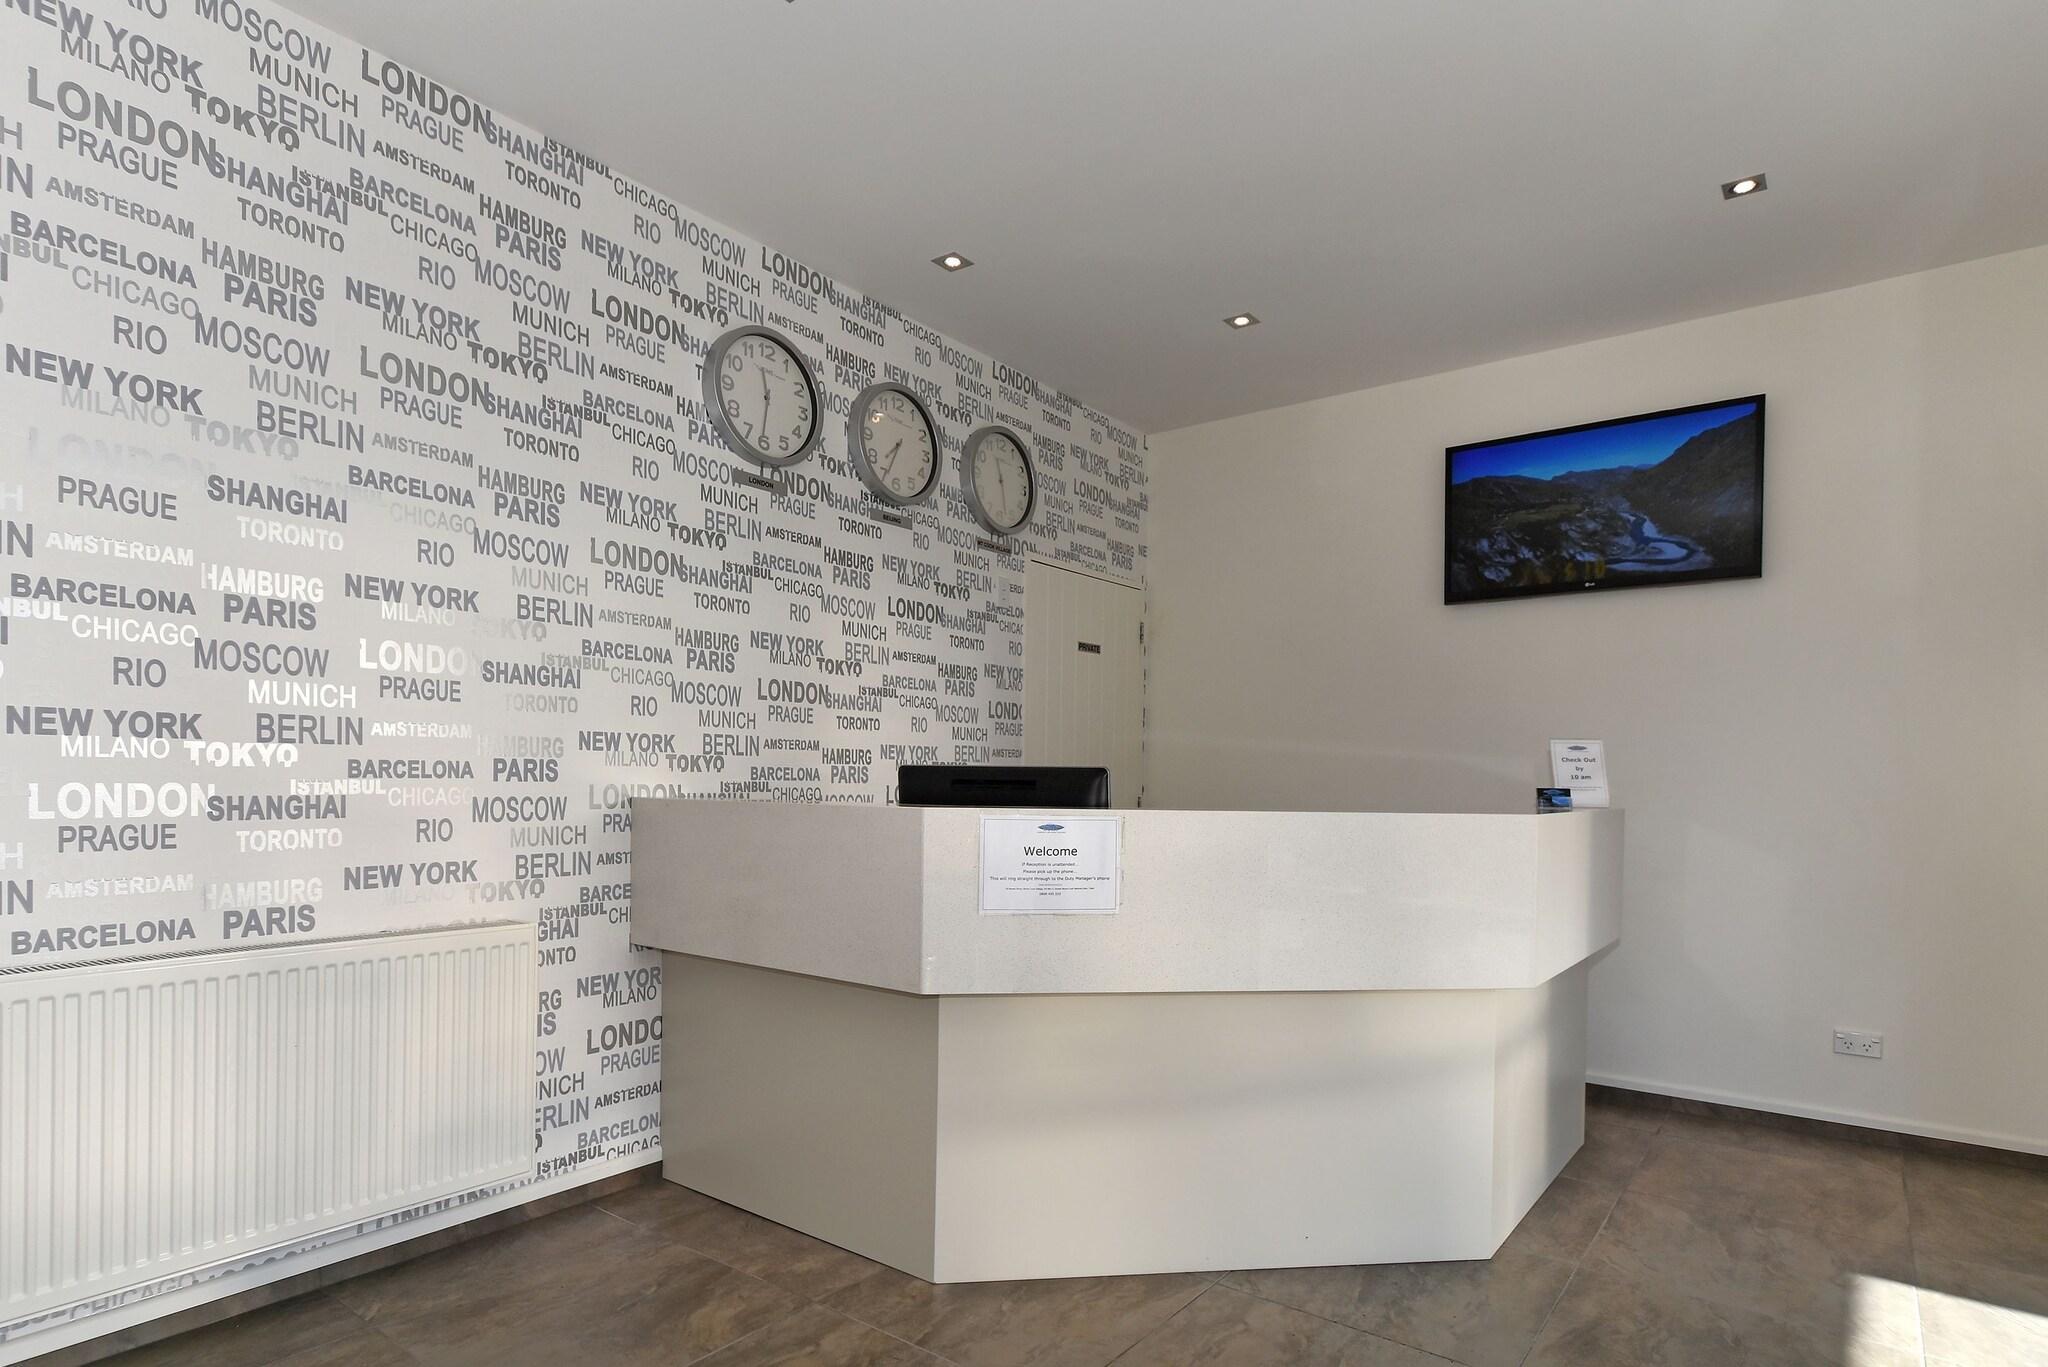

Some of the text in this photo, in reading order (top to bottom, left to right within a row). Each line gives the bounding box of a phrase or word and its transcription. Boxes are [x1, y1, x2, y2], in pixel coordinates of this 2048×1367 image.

[60, 30, 169, 97] MILANO
[106, 22, 202, 90] YORK
[248, 47, 356, 119] MUNICH
[361, 49, 490, 140] LONDON
[27, 66, 216, 173] LONDON
[184, 85, 298, 155] TOKYO
[256, 84, 363, 159] BERLIN
[381, 95, 463, 154] PRAGUE
[57, 122, 177, 191] PRAGUE
[374, 138, 474, 196] AMSTERDAM
[483, 120, 583, 187] SHANGHAI
[206, 149, 348, 227] SHANGHAI
[291, 166, 387, 218] ISTANBUL
[350, 168, 475, 237] BARCELONA
[504, 160, 580, 211] TORONTO
[613, 176, 677, 223] CHICAGO
[47, 175, 193, 242] AMSTERDAM
[237, 197, 343, 255] TORONTO
[479, 193, 565, 251] HAMBURG
[11, 211, 195, 290] BARCELONA
[494, 223, 560, 272] PARIS
[201, 238, 323, 303] HAMBURG
[418, 256, 455, 292] RIO
[474, 255, 568, 315] MOSCOW
[762, 246, 833, 301] LONDON
[70, 264, 198, 323] CHICAGO
[223, 273, 316, 328] PARIS
[346, 277, 480, 342] NEW YORK
[382, 311, 457, 353] MILANO
[511, 301, 588, 347] MUNICH
[591, 287, 685, 348] LONDON
[841, 315, 884, 348] TORONTO
[113, 316, 166, 357] RIO
[194, 312, 327, 378] MOSCOW
[742, 341, 754, 358] 11
[758, 342, 776, 361] 12
[467, 341, 546, 385] TOKYO
[517, 331, 593, 380] BERLIN
[726, 353, 743, 372] 10
[783, 359, 789, 373] 1
[6, 345, 202, 416] NEW YORK
[360, 344, 488, 410] LONDON
[722, 374, 734, 391] 9
[793, 382, 804, 399] 2
[994, 360, 1039, 398] LONDON
[380, 386, 462, 429] PRAGUE
[482, 391, 581, 439] SHANGHAI
[727, 399, 740, 418] 8
[798, 406, 808, 421] 3
[256, 399, 362, 453] BERLIN
[743, 421, 754, 439] 7
[758, 435, 770, 451] 6
[778, 435, 789, 450] 5
[792, 425, 802, 439] 4
[503, 427, 578, 463] TORONTO
[58, 476, 177, 521] PRAGUE
[206, 474, 347, 523] SHANGHAI
[349, 465, 474, 509] BARCELONA
[478, 465, 563, 505] HAMBURG
[700, 483, 757, 514] MUNICH
[748, 476, 774, 489] LONDON
[1074, 478, 1111, 508] LONDON
[493, 491, 558, 528] PARIS
[580, 481, 677, 522] NEW YORK
[667, 522, 726, 551] TOKYO
[704, 508, 761, 541] BERLIN
[766, 525, 821, 549] AMSTERDAM
[47, 530, 192, 568] AMSTERDAM
[473, 527, 567, 568] MOSCOW
[590, 536, 683, 578] LONDON
[753, 551, 822, 578] BARCELONA
[824, 545, 873, 573] HAMBURG
[12, 573, 195, 615] BARCELONA
[200, 563, 322, 603] HAMBURG
[345, 573, 478, 612] NEW YORK
[604, 570, 663, 598] PRAGUE
[678, 563, 752, 594] SHANGHAI
[774, 576, 823, 599] CHICAGO
[833, 565, 870, 590] PARIS
[222, 593, 315, 630] PARIS
[516, 594, 591, 628] BERLIN
[694, 592, 750, 615] TORONTO
[888, 595, 944, 625] LONDON
[71, 614, 197, 648] CHICAGO
[675, 627, 738, 653] HAMBURG
[842, 620, 886, 641] MUNICH
[193, 637, 327, 677] MOSCOW
[581, 639, 672, 664] BARCELONA
[686, 648, 735, 673] PARIS
[817, 657, 862, 677] TOKYO
[113, 657, 166, 688] RIO
[481, 660, 580, 689] SHANGHAI
[939, 662, 978, 681] HAMBURG
[247, 679, 354, 708] MUNICH
[758, 677, 829, 705] LONDON
[7, 706, 202, 739] NEW YORK
[255, 712, 361, 745] BERLIN
[837, 715, 880, 731] TORONTO
[60, 735, 169, 759] MILANO
[183, 742, 296, 767] TOKYO
[290, 779, 385, 795] ISTANBUL
[348, 759, 473, 779] BARCELONA
[492, 758, 557, 781] PARIS
[28, 783, 215, 819] LONDON
[206, 795, 346, 821] SHANGHAI
[58, 823, 177, 852] PRAGUE
[1024, 846, 1078, 857] Welcome
[344, 860, 477, 890] NEW YORK
[514, 851, 590, 879] BERLIN
[222, 904, 314, 938] PARIS
[539, 902, 606, 921] ISTANBUL
[12, 917, 195, 954] BARCELONA
[603, 985, 656, 1009] MILANO
[601, 1044, 660, 1075] PRAGUE
